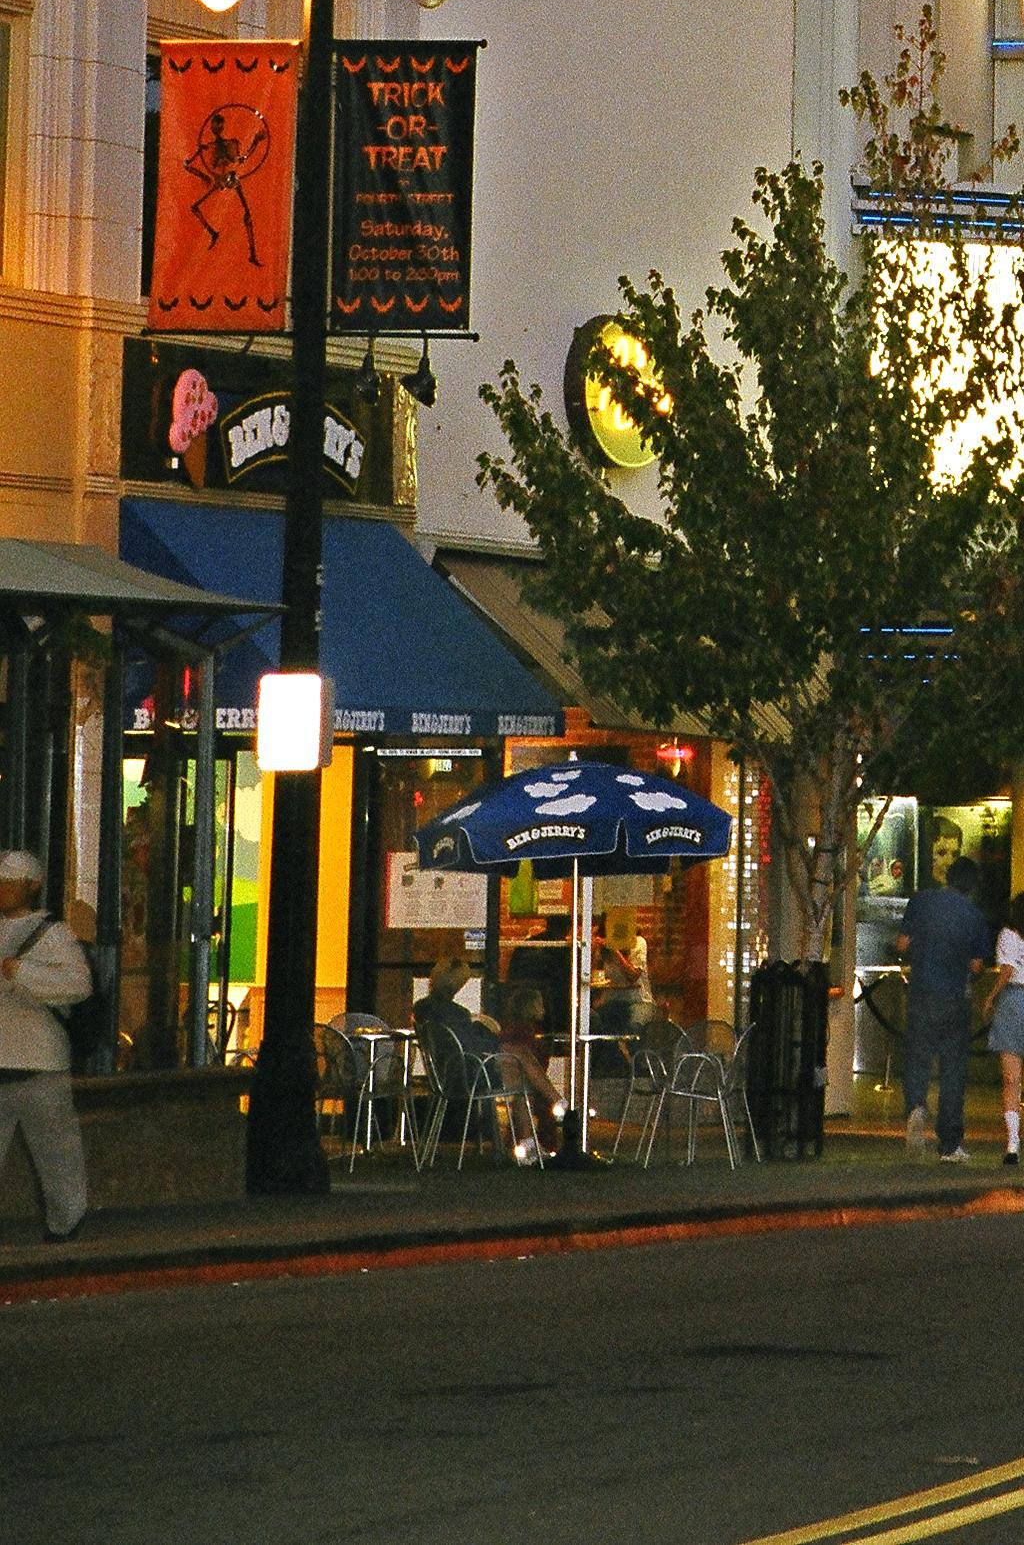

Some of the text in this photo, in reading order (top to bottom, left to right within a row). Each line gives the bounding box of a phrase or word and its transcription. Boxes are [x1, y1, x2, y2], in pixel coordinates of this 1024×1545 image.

[366, 81, 446, 109] TRICK
[362, 145, 448, 173] TREAT
[349, 244, 412, 261] October
